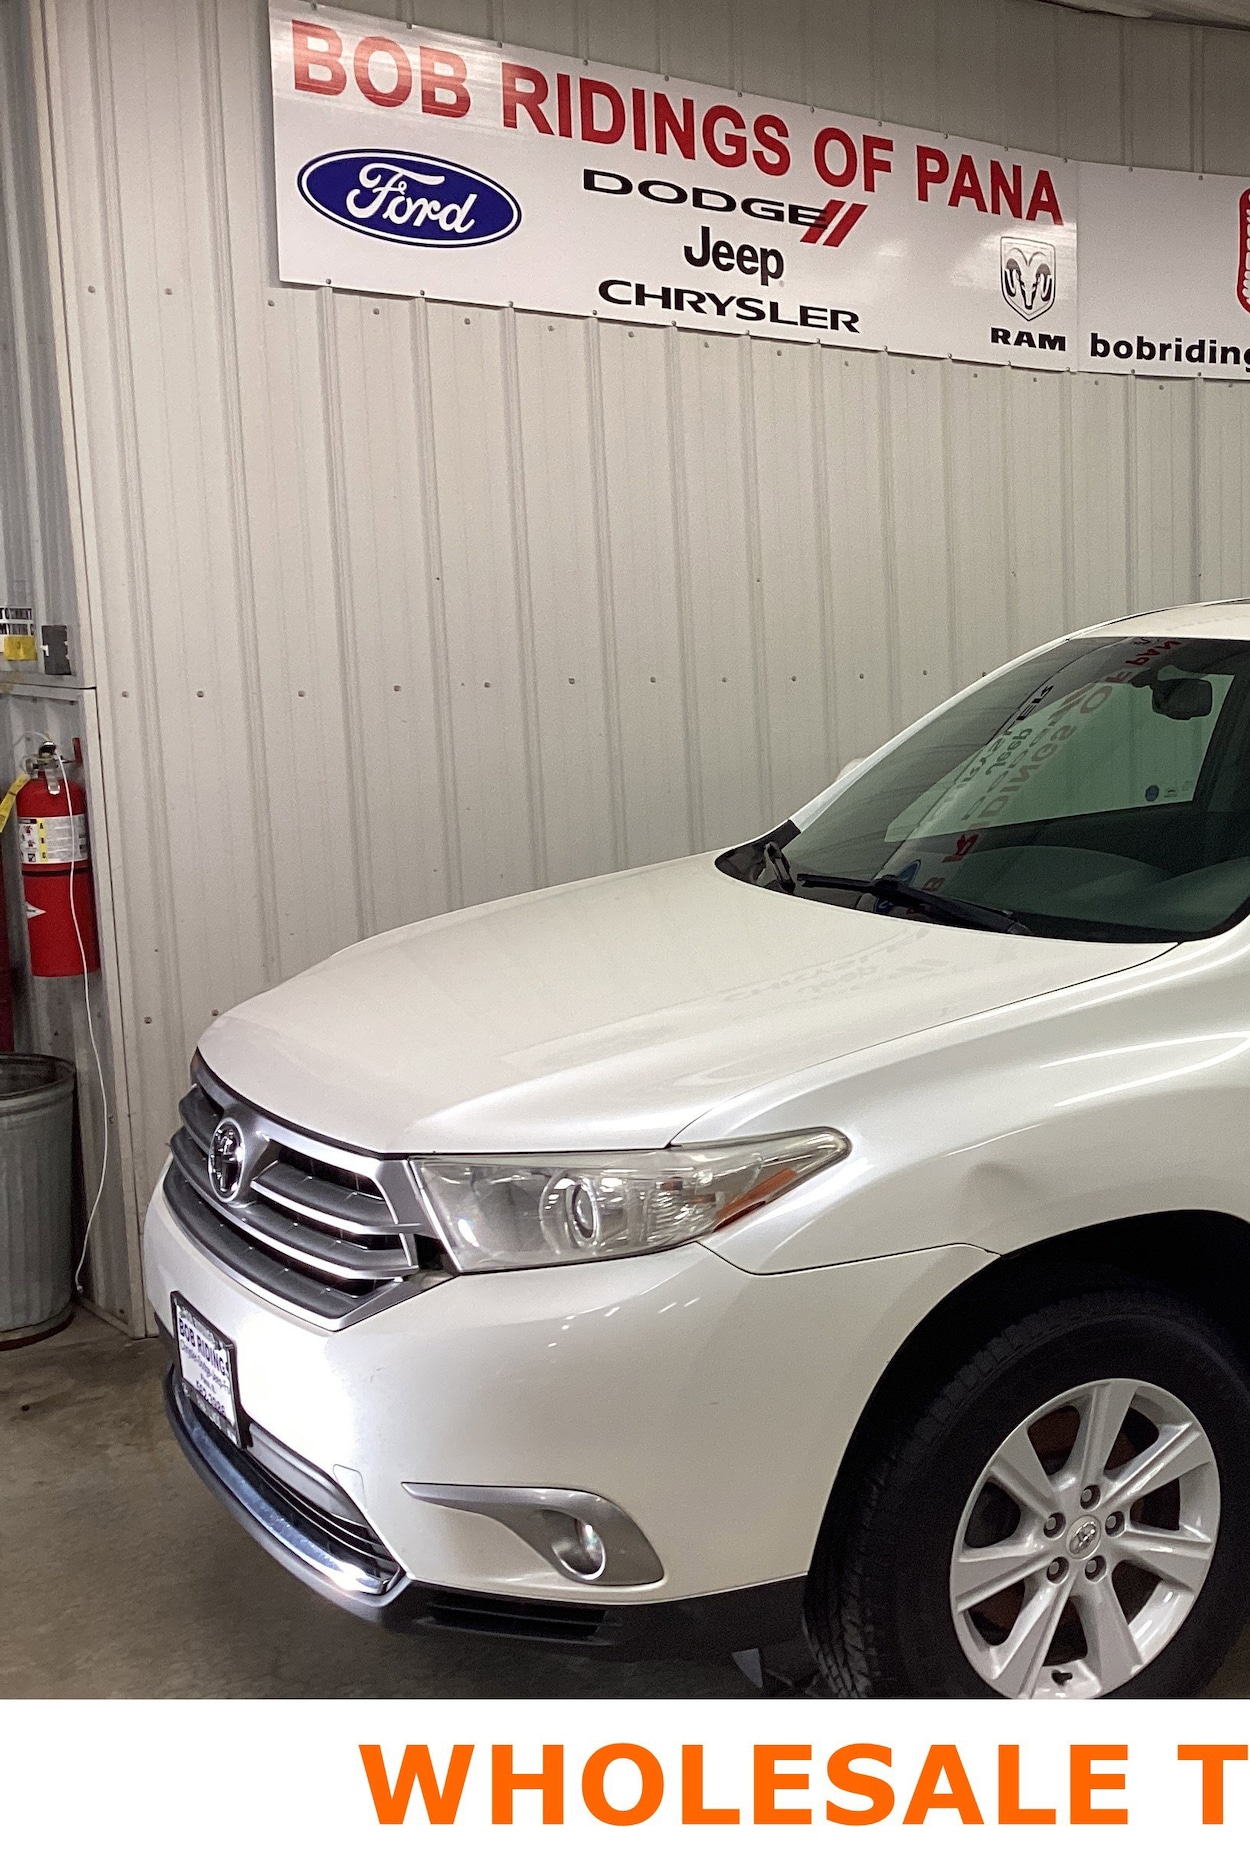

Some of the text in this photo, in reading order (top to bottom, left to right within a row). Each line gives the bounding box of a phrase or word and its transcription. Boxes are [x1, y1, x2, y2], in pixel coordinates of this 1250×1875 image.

[292, 20, 1064, 226] BOB RIDINGS OF PANA
[345, 162, 478, 234] Ford
[583, 168, 828, 230] DODGE
[684, 225, 785, 287] Jeep
[598, 279, 861, 334] CHRYSLER
[989, 326, 1067, 352] RAM
[178, 1317, 196, 1348] BOB
